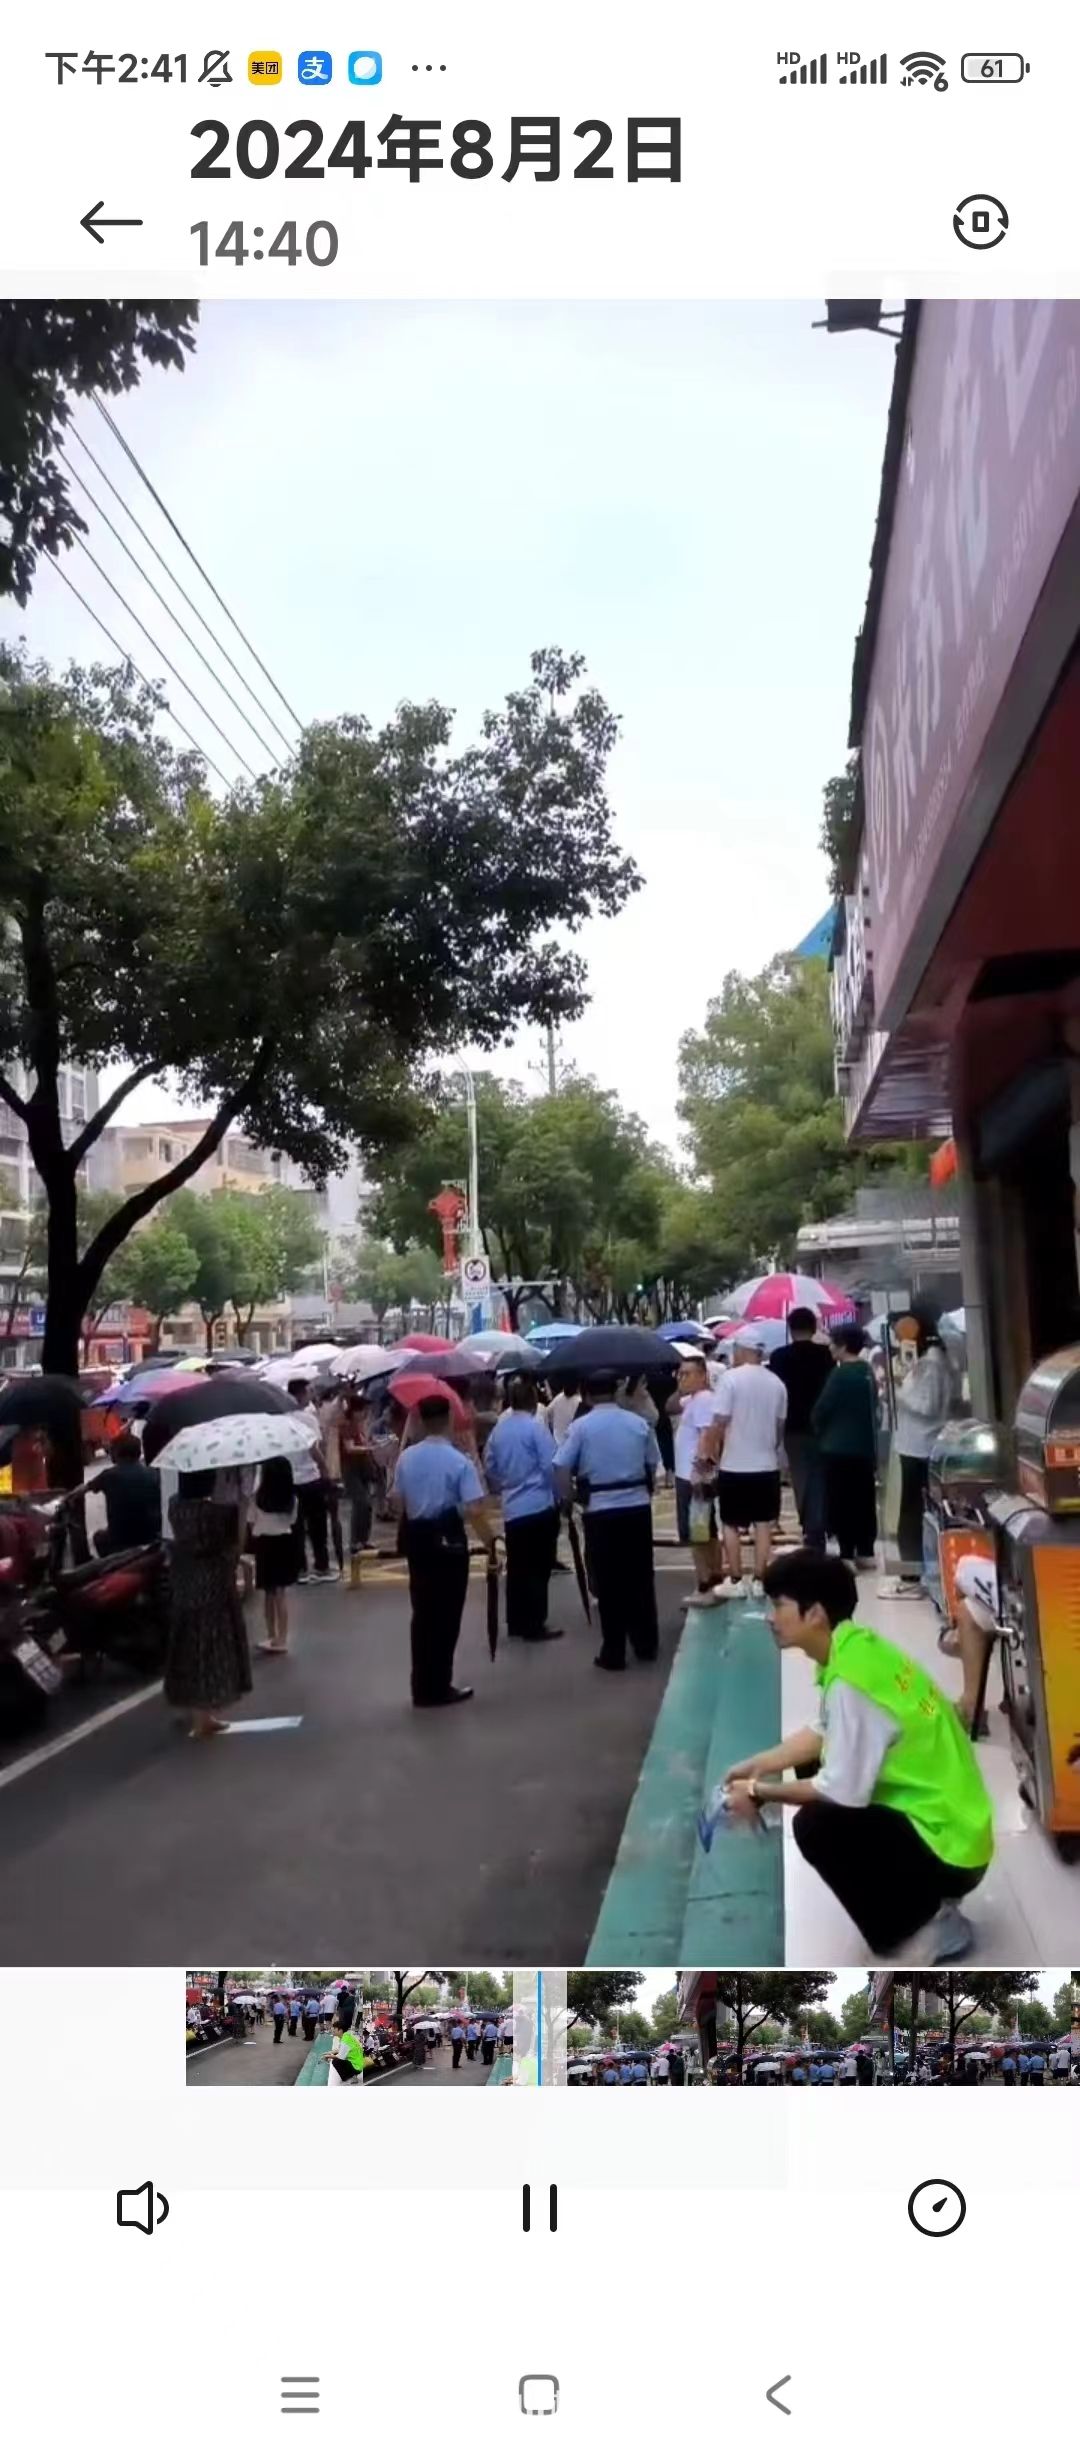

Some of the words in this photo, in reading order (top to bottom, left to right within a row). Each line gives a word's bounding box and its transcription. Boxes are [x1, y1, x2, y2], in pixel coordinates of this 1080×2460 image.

[45, 50, 186, 84] 下午2:41
[252, 62, 278, 74] 美团
[301, 56, 329, 80] 支
[777, 52, 800, 64] HD
[838, 52, 860, 64] HD
[981, 60, 1002, 77] 61
[934, 70, 948, 92] 6
[191, 114, 681, 182] 2024年8月2日
[191, 221, 338, 266] 14:40
